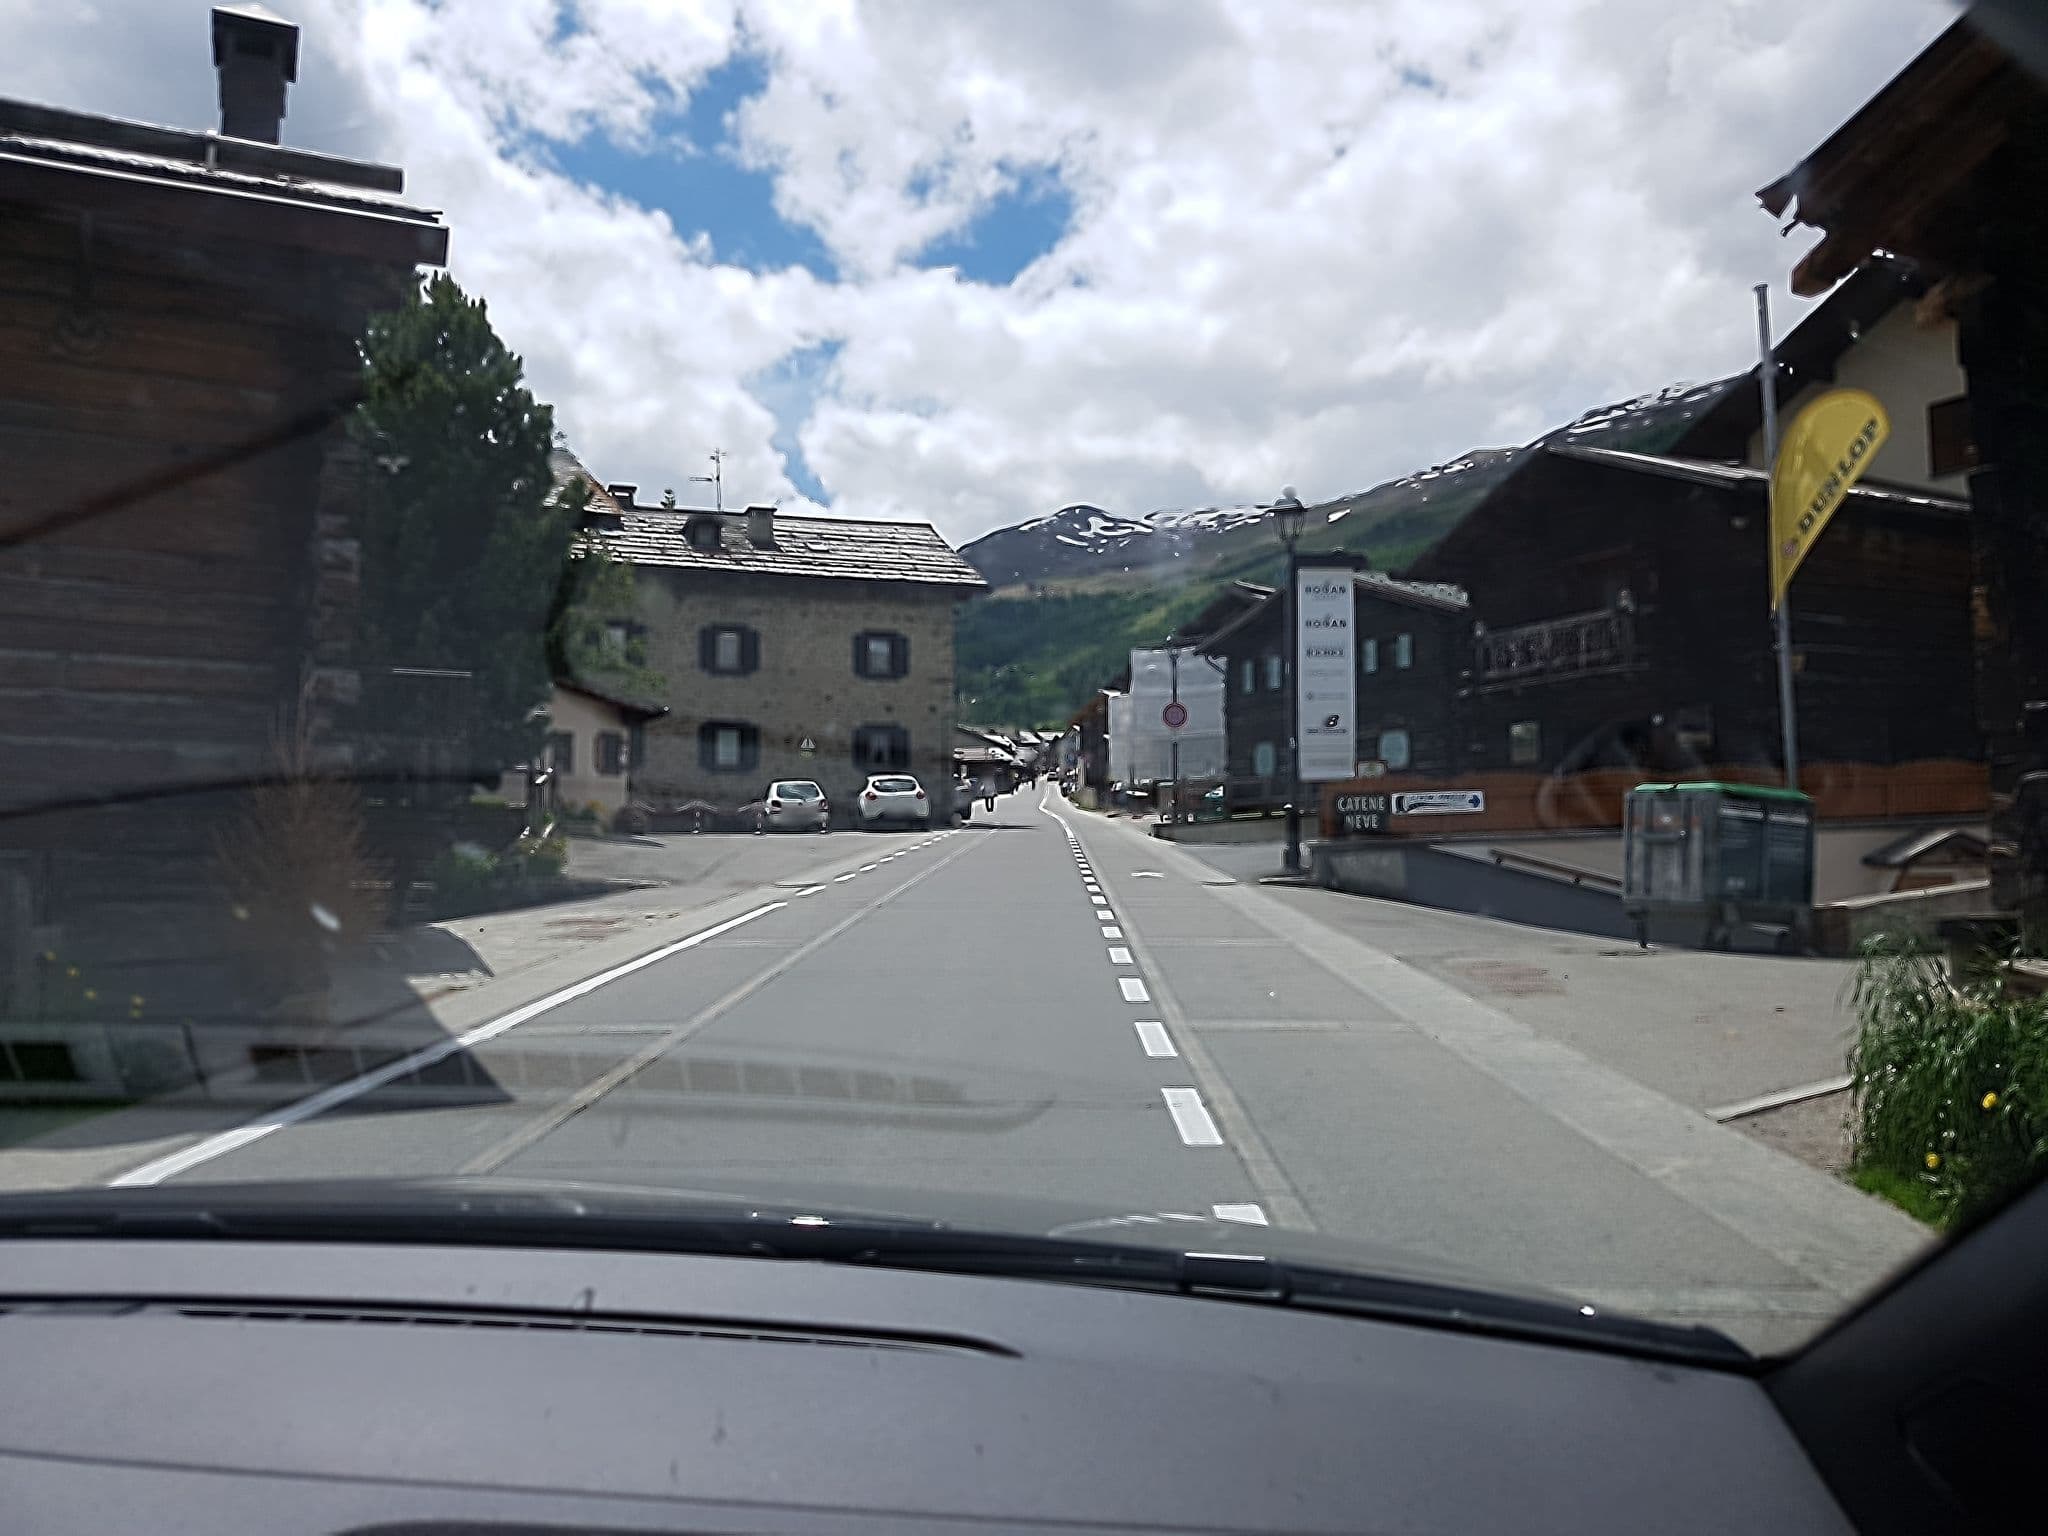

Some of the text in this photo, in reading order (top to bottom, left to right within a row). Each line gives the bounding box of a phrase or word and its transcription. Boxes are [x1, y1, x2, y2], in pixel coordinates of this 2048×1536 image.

[1799, 419, 1878, 534] DUNLOP
[1337, 796, 1386, 812] CATENE
[1344, 813, 1379, 829] NEVE
